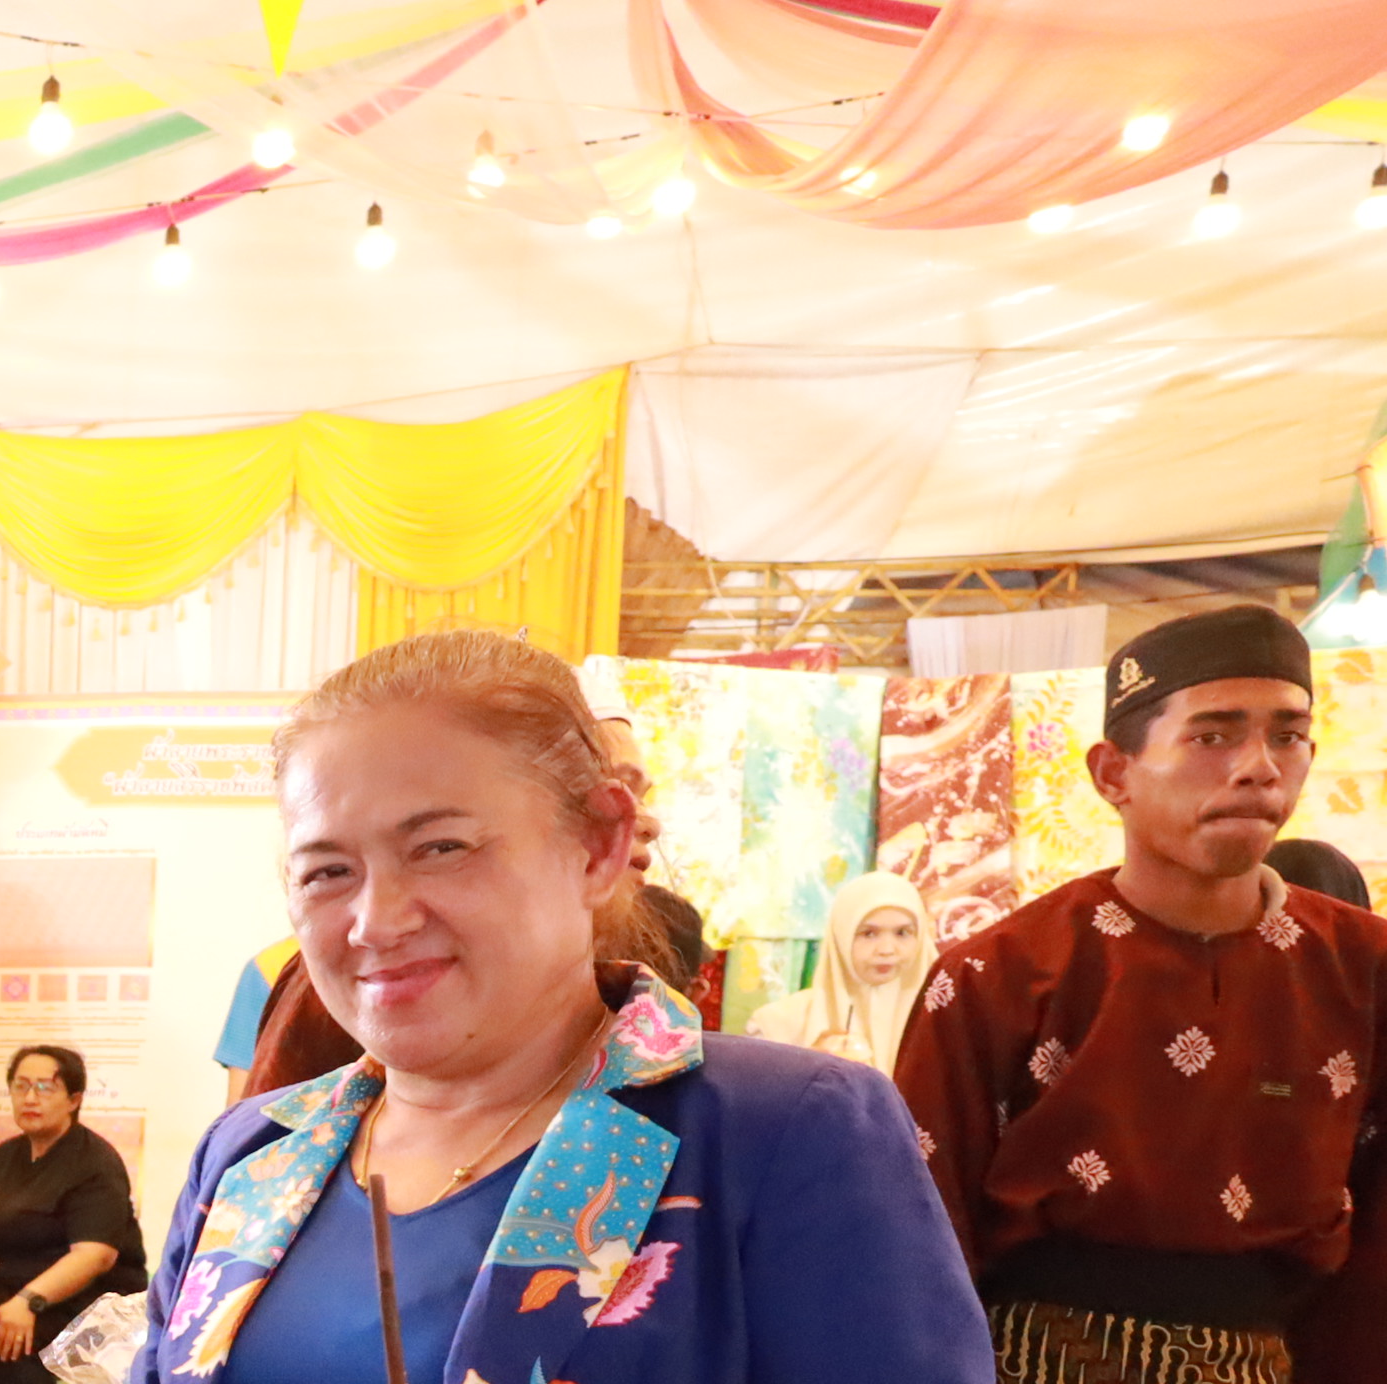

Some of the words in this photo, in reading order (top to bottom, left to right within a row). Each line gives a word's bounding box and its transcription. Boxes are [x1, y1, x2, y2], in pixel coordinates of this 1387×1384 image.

[143, 729, 275, 760] ผ้าลายพระราช
